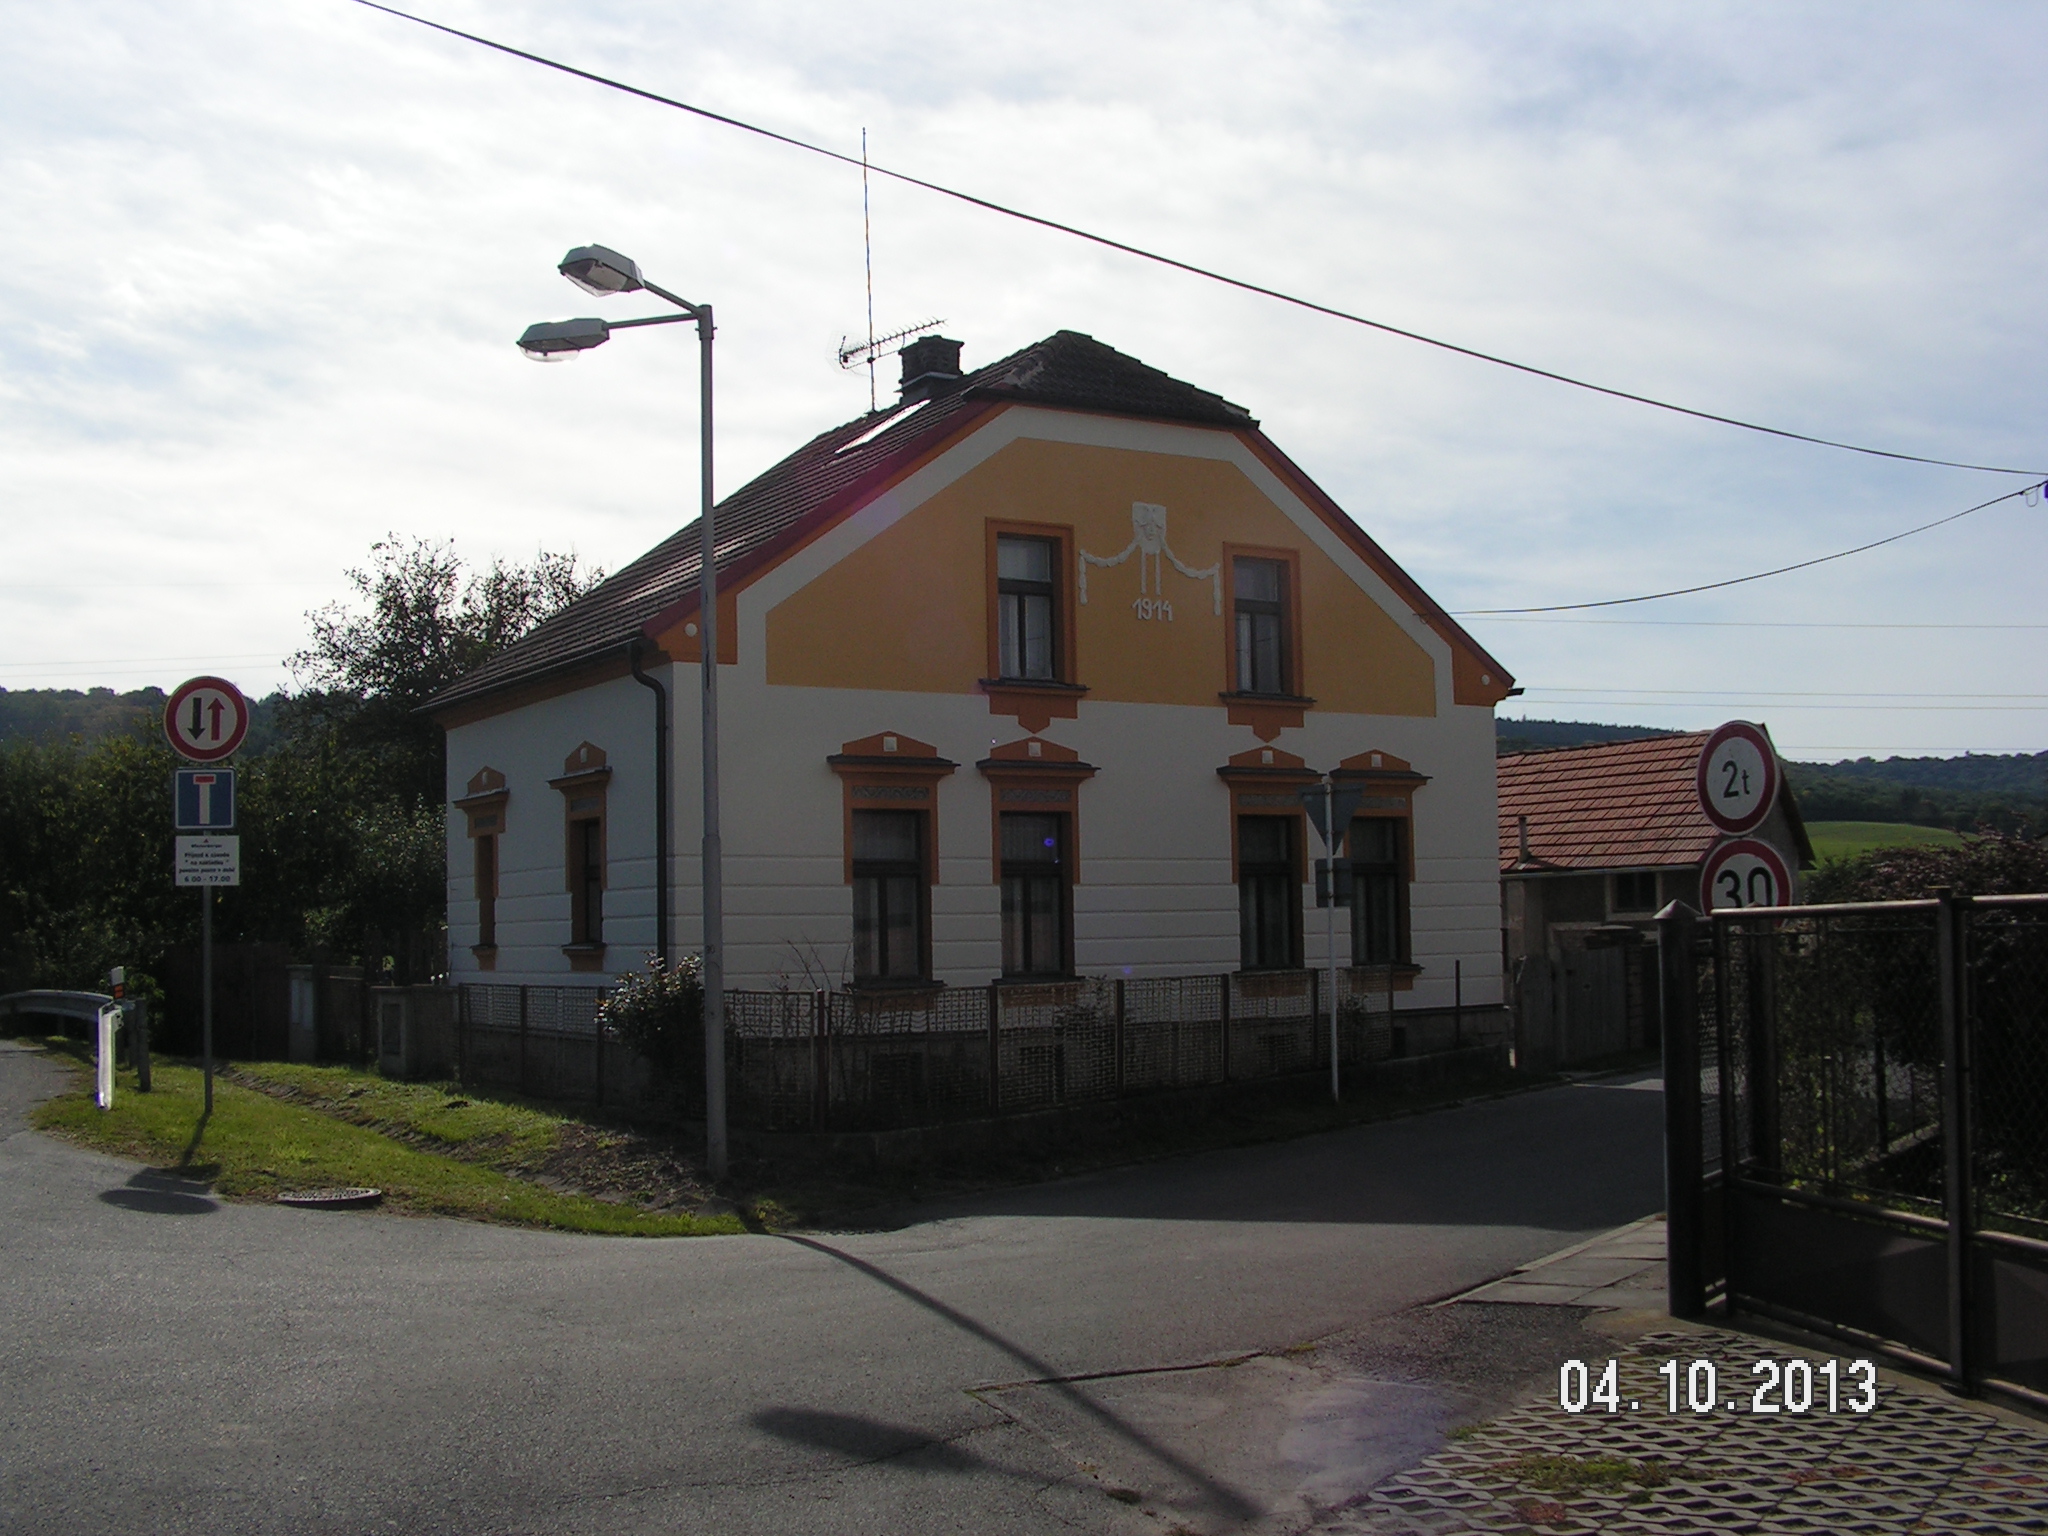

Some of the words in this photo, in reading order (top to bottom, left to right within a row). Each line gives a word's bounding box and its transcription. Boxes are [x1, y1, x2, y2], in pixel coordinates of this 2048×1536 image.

[1131, 597, 1173, 622] 1914
[1721, 760, 1751, 799] 2t
[1716, 866, 1773, 908] 30
